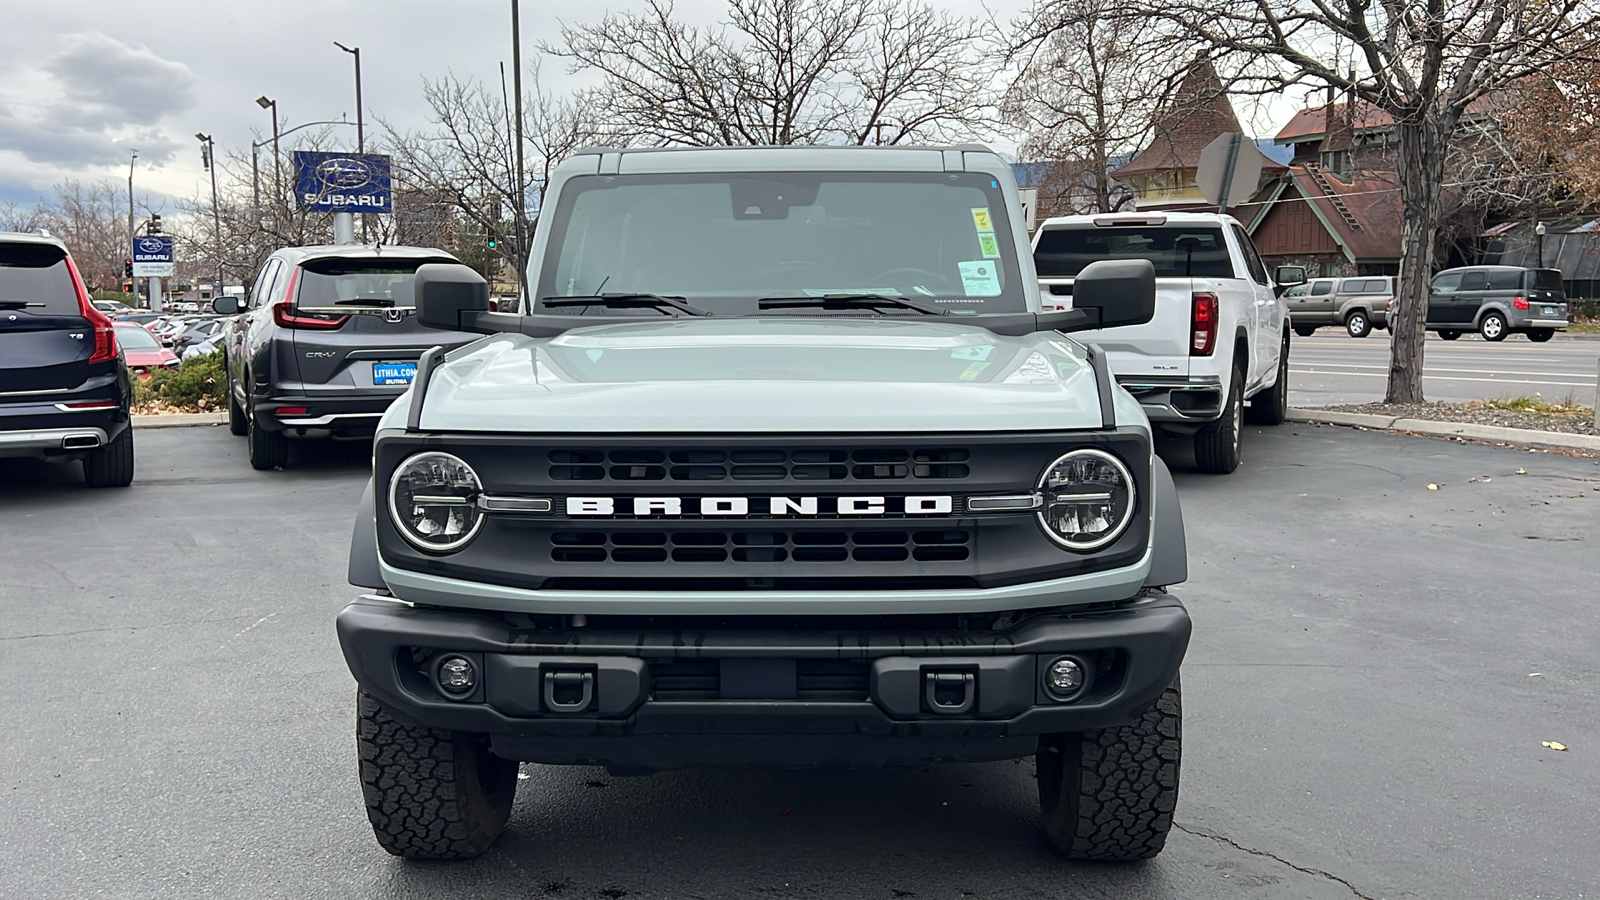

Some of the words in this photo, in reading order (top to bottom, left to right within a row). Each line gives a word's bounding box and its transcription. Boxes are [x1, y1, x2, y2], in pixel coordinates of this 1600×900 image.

[304, 193, 384, 207] SUBARU
[374, 369, 416, 378] LITHIA.COM
[566, 495, 953, 516] BRONCO
